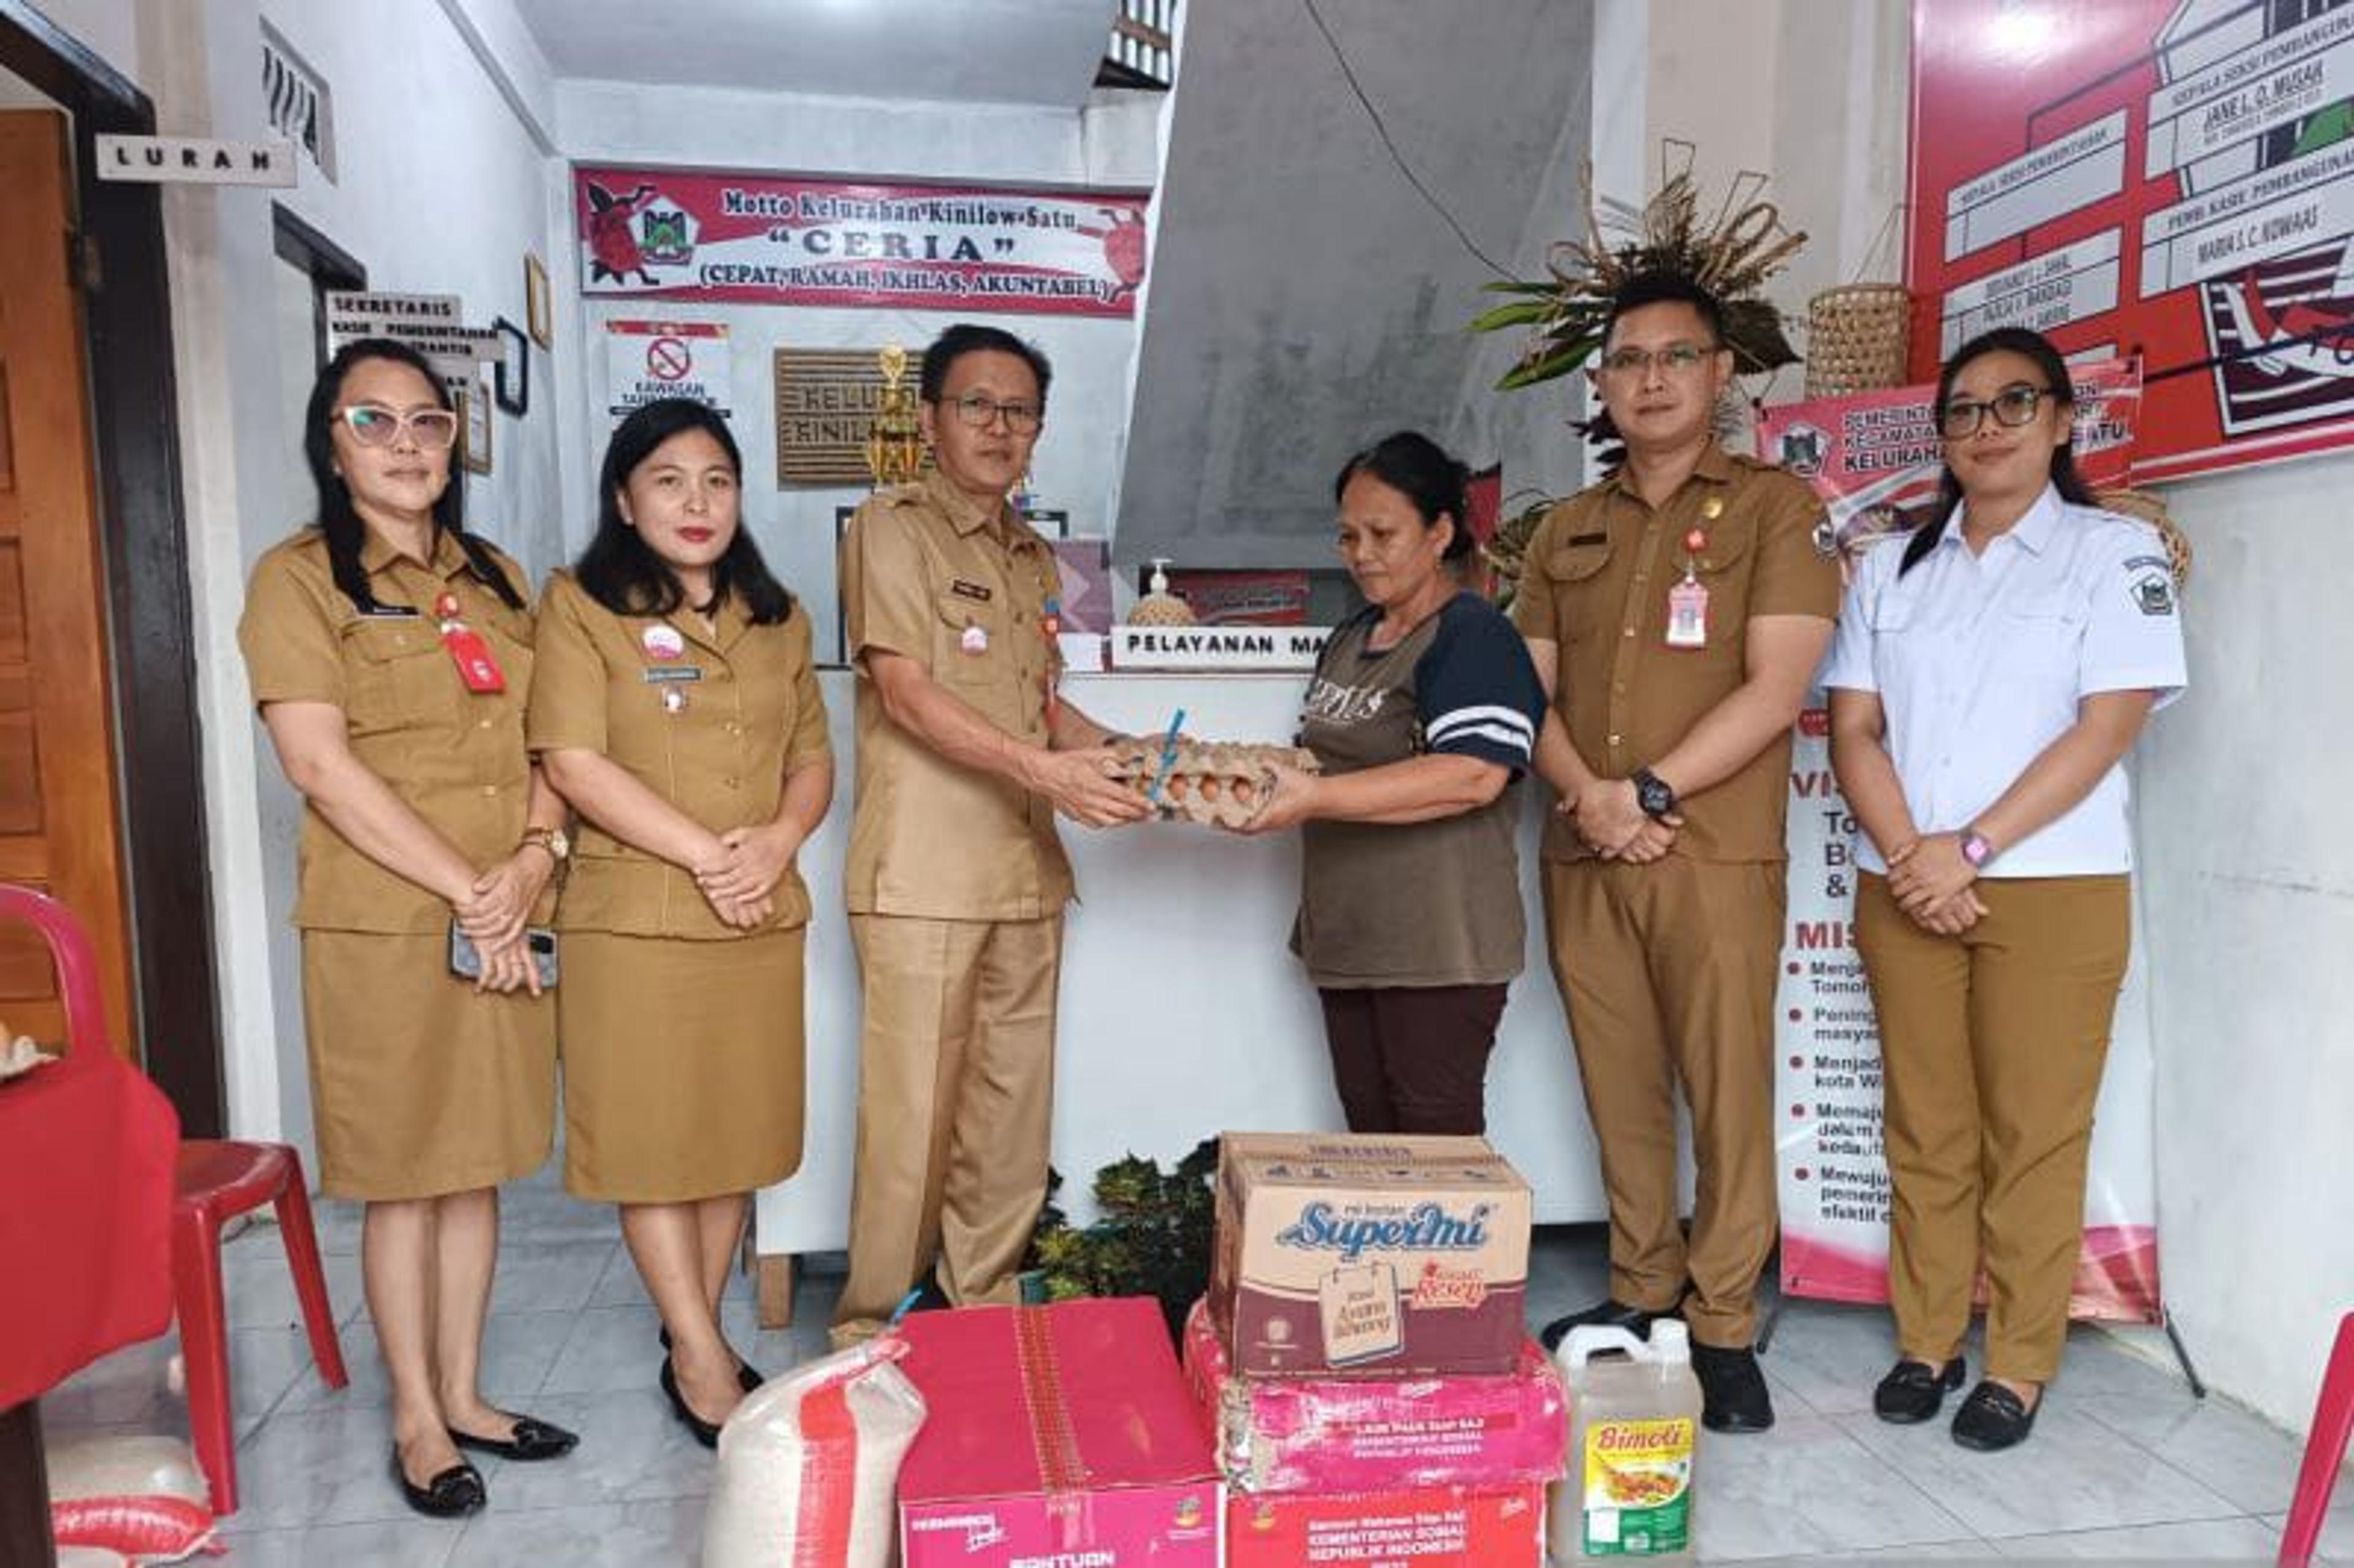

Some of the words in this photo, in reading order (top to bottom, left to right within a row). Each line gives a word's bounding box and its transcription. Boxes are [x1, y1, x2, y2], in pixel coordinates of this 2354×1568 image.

[116, 147, 271, 170] LURAH
[725, 191, 793, 215] Motto
[801, 193, 918, 222] Kelurahan
[1127, 634, 1273, 653] PELAYANAN
[1290, 635, 1326, 652] MA
[1823, 811, 1858, 834] To
[1826, 873, 1848, 898] &
[1598, 1423, 1682, 1450] Bimoli
